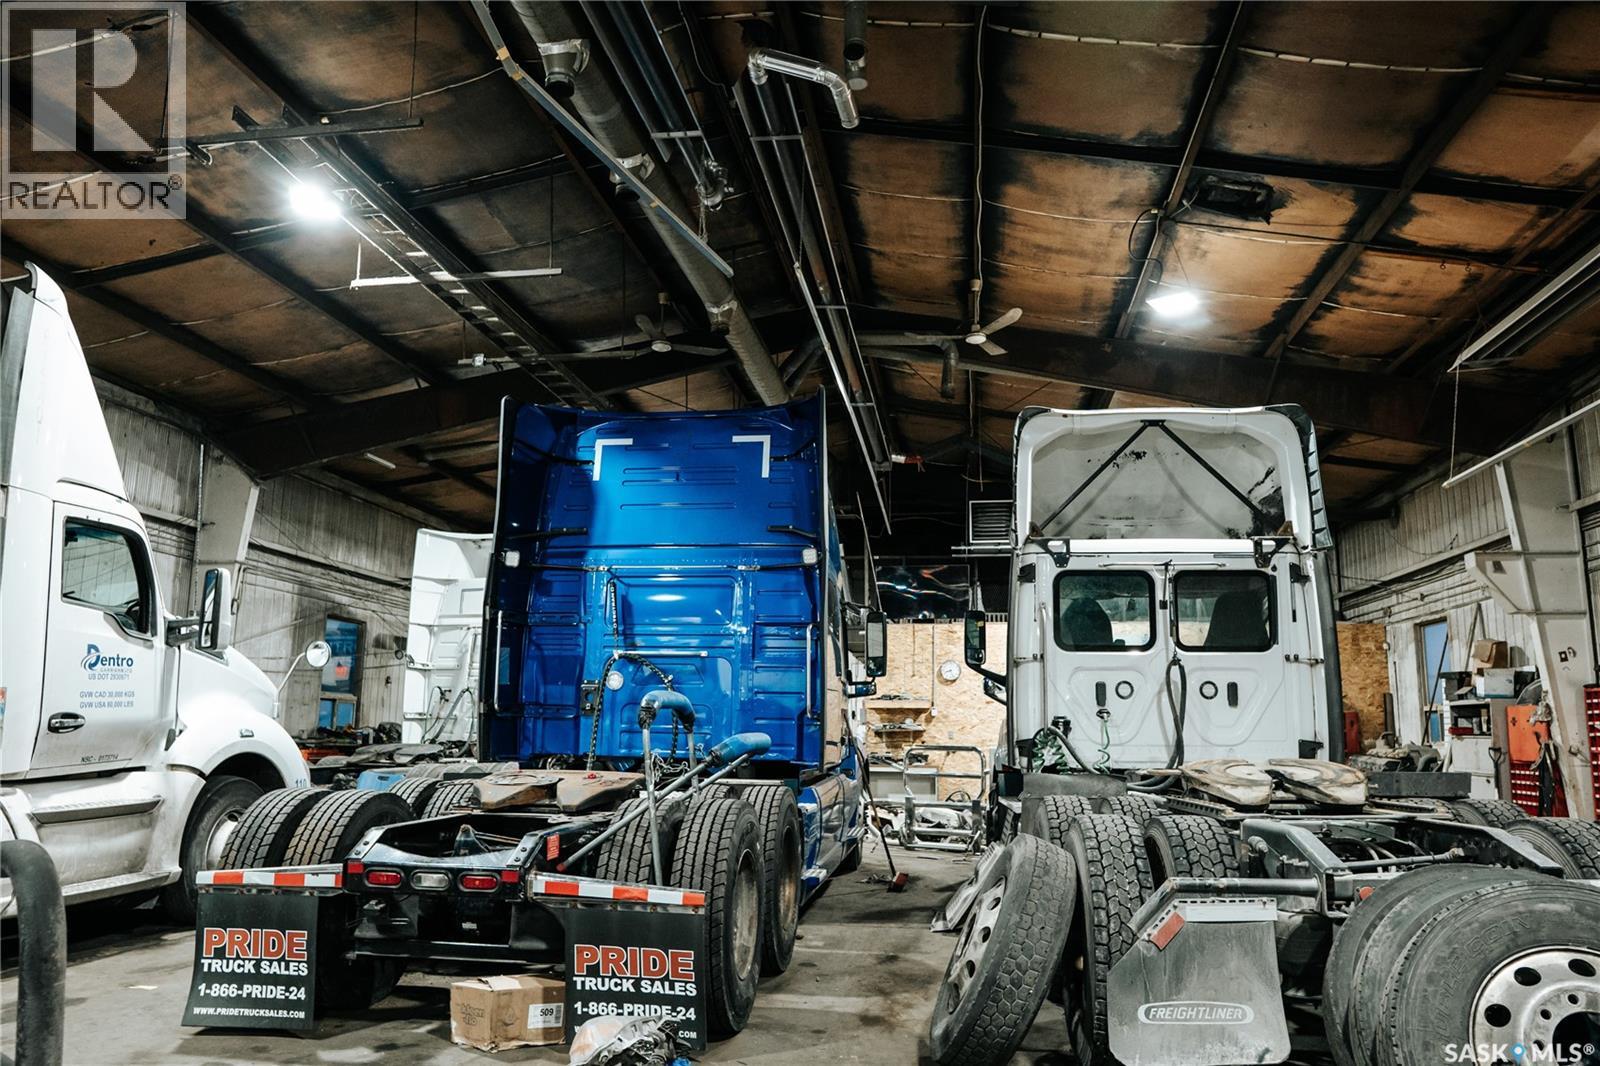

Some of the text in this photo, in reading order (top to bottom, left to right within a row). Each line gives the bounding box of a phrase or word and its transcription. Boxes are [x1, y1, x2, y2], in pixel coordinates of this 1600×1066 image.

[81, 644, 133, 671] Dentro
[80, 701, 93, 709] GVW
[94, 701, 106, 709] USA
[203, 927, 308, 961] PRIDE
[200, 958, 308, 976] TRUCK SALES
[574, 944, 695, 982] PRIDE
[198, 983, 306, 1000] 1-866-PRIDE-24
[573, 976, 697, 996] TRUCK SALES
[193, 1007, 305, 1019] WWW.PRIDETRUCKSALES.COM
[540, 1008, 554, 1017] 509
[574, 1001, 696, 1020] 1-866-PRIDE-24
[1149, 1006, 1242, 1019] FREIGHTLINER
